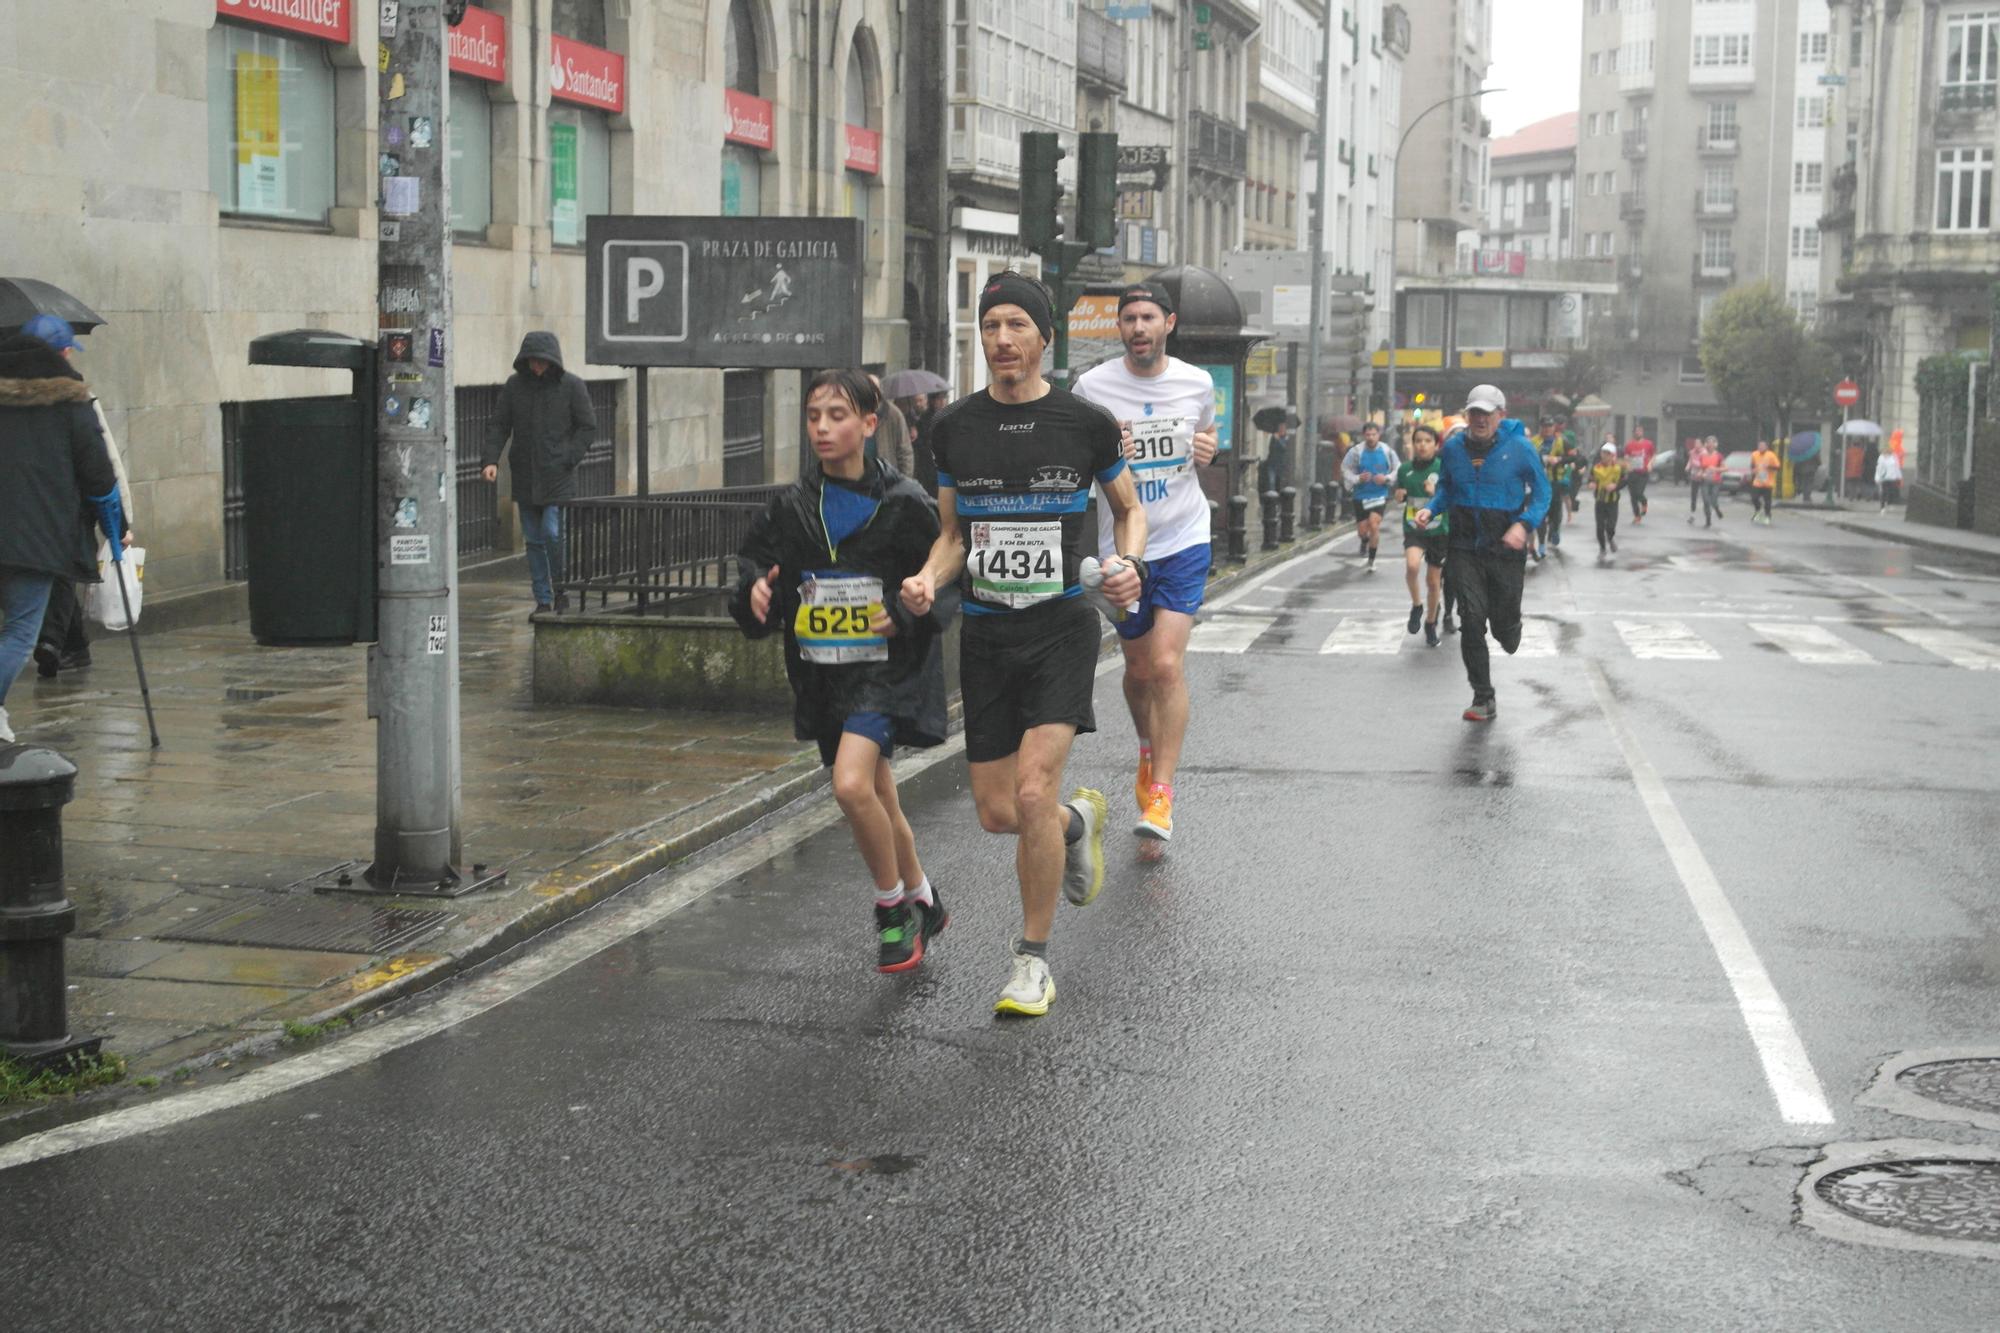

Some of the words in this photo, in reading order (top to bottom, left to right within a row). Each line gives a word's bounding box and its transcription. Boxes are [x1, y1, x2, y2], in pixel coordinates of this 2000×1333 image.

[249, 0, 341, 27] ntander
[448, 25, 498, 67] ntander
[567, 58, 618, 103] Santander
[733, 107, 769, 142] Santander
[703, 240, 750, 258] PRAZA
[754, 240, 772, 257] DE
[776, 240, 838, 258] GALICIA
[627, 257, 664, 323] P
[1136, 478, 1169, 504] 10K
[975, 550, 1055, 579] 1434
[809, 606, 869, 633] 625
